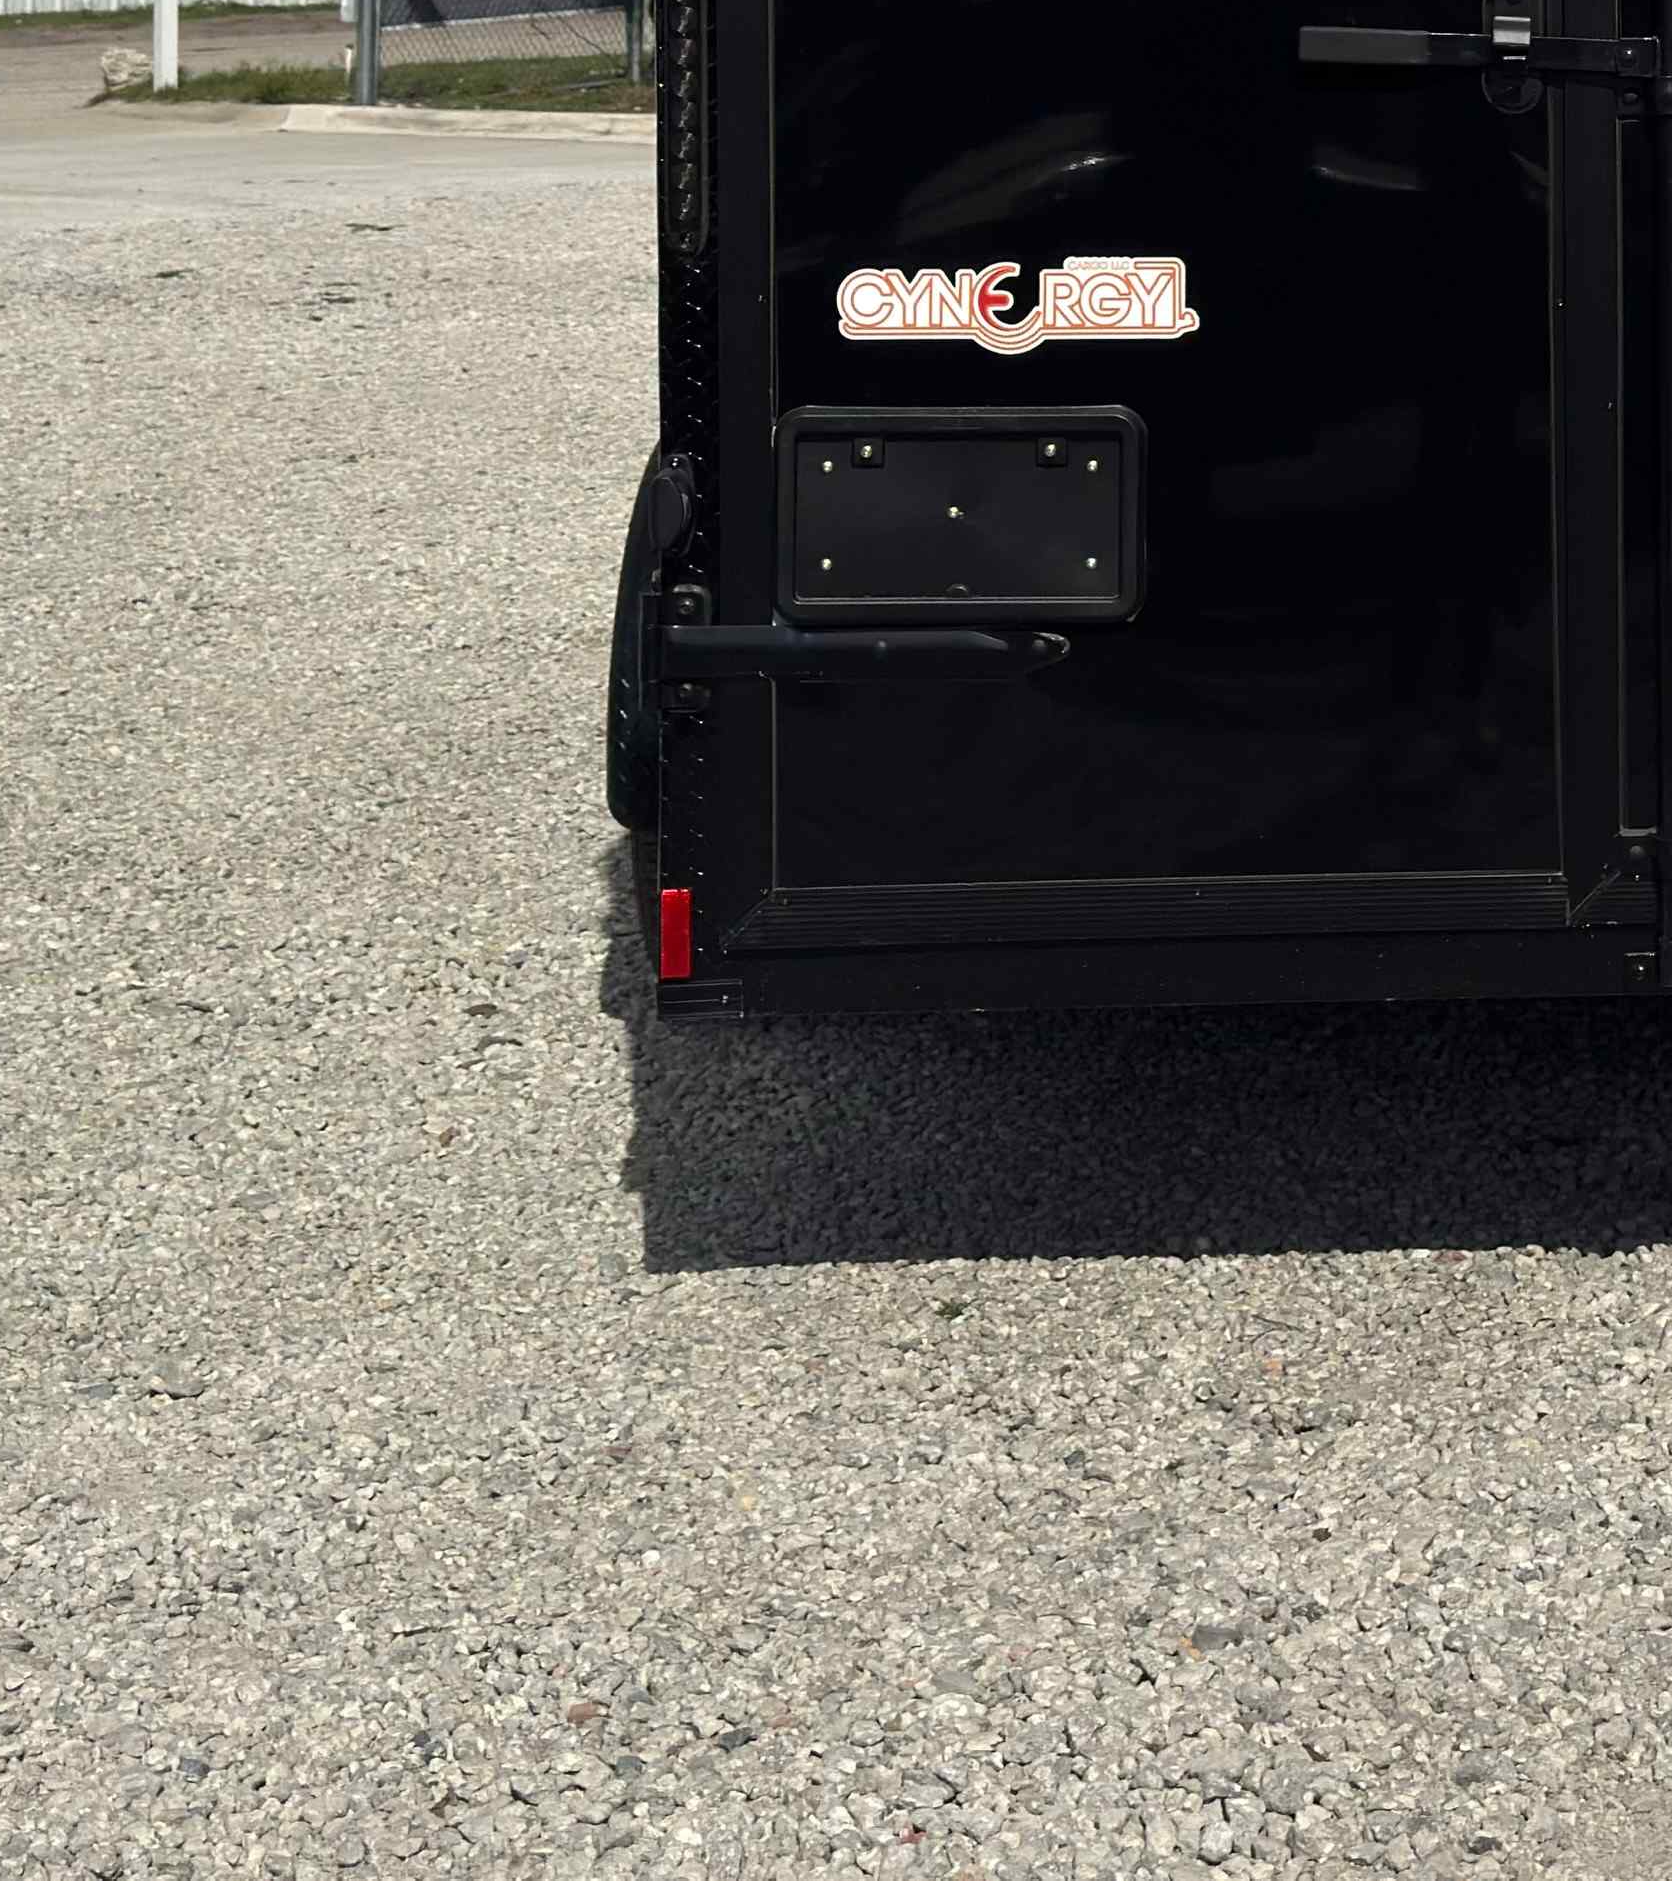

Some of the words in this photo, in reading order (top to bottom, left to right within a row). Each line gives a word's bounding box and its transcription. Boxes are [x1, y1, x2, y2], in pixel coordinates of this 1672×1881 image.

[1068, 260, 1108, 271] CARGO
[1111, 260, 1129, 270] LLC
[840, 264, 1177, 331] CYNERGY
